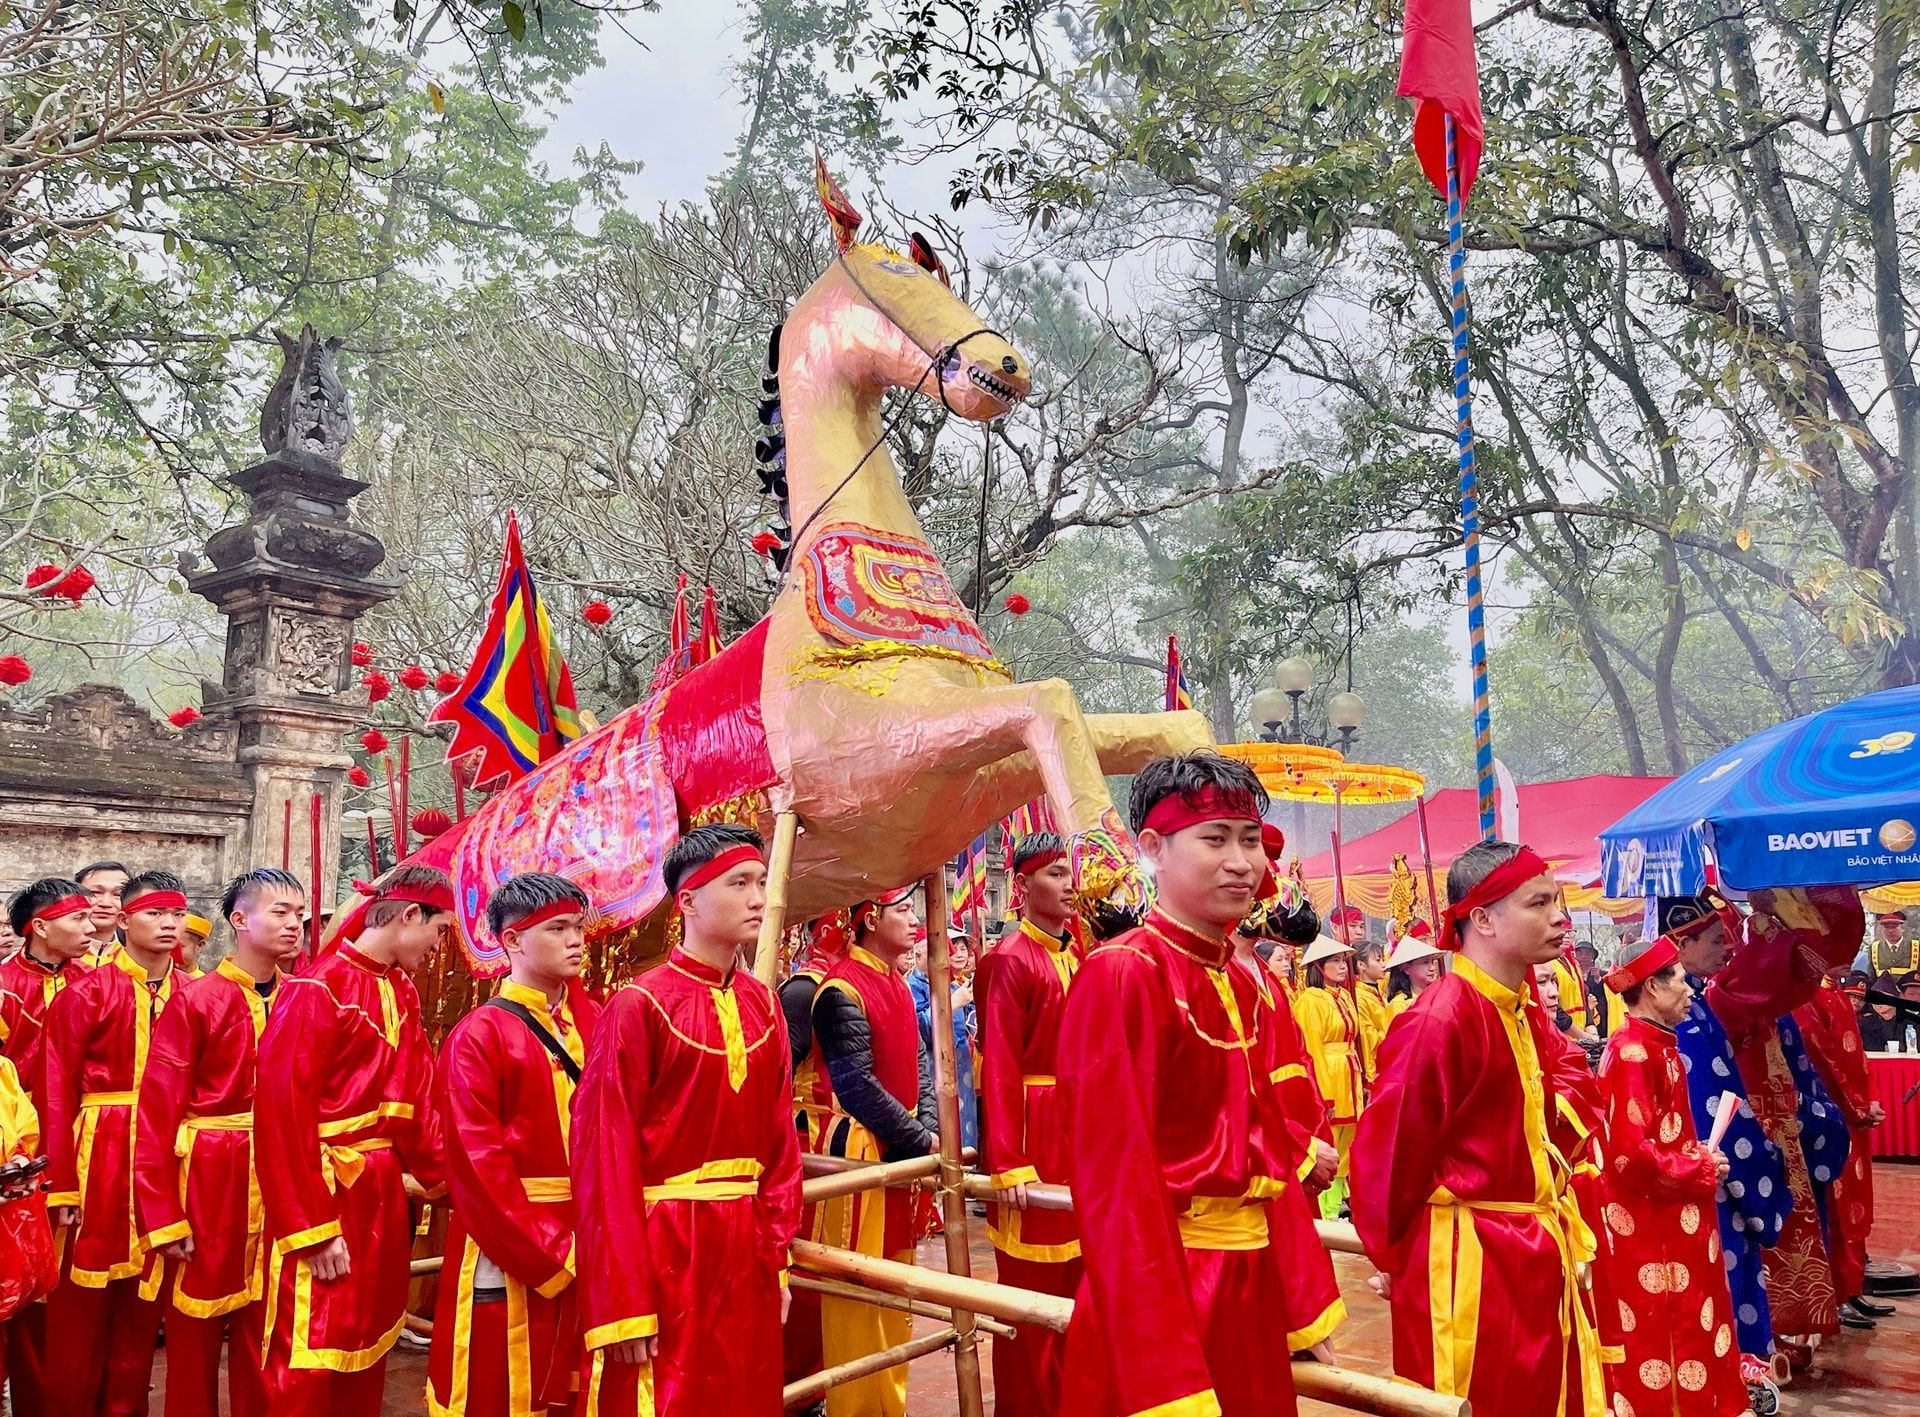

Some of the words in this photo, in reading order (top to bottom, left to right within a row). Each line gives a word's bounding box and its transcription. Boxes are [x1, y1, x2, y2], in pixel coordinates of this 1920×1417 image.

[1768, 828, 1872, 852] BAOVIET
[1847, 855, 1869, 867] BẢO
[1871, 854, 1893, 866] VIỆT
[1895, 853, 1920, 864] NHÂ
